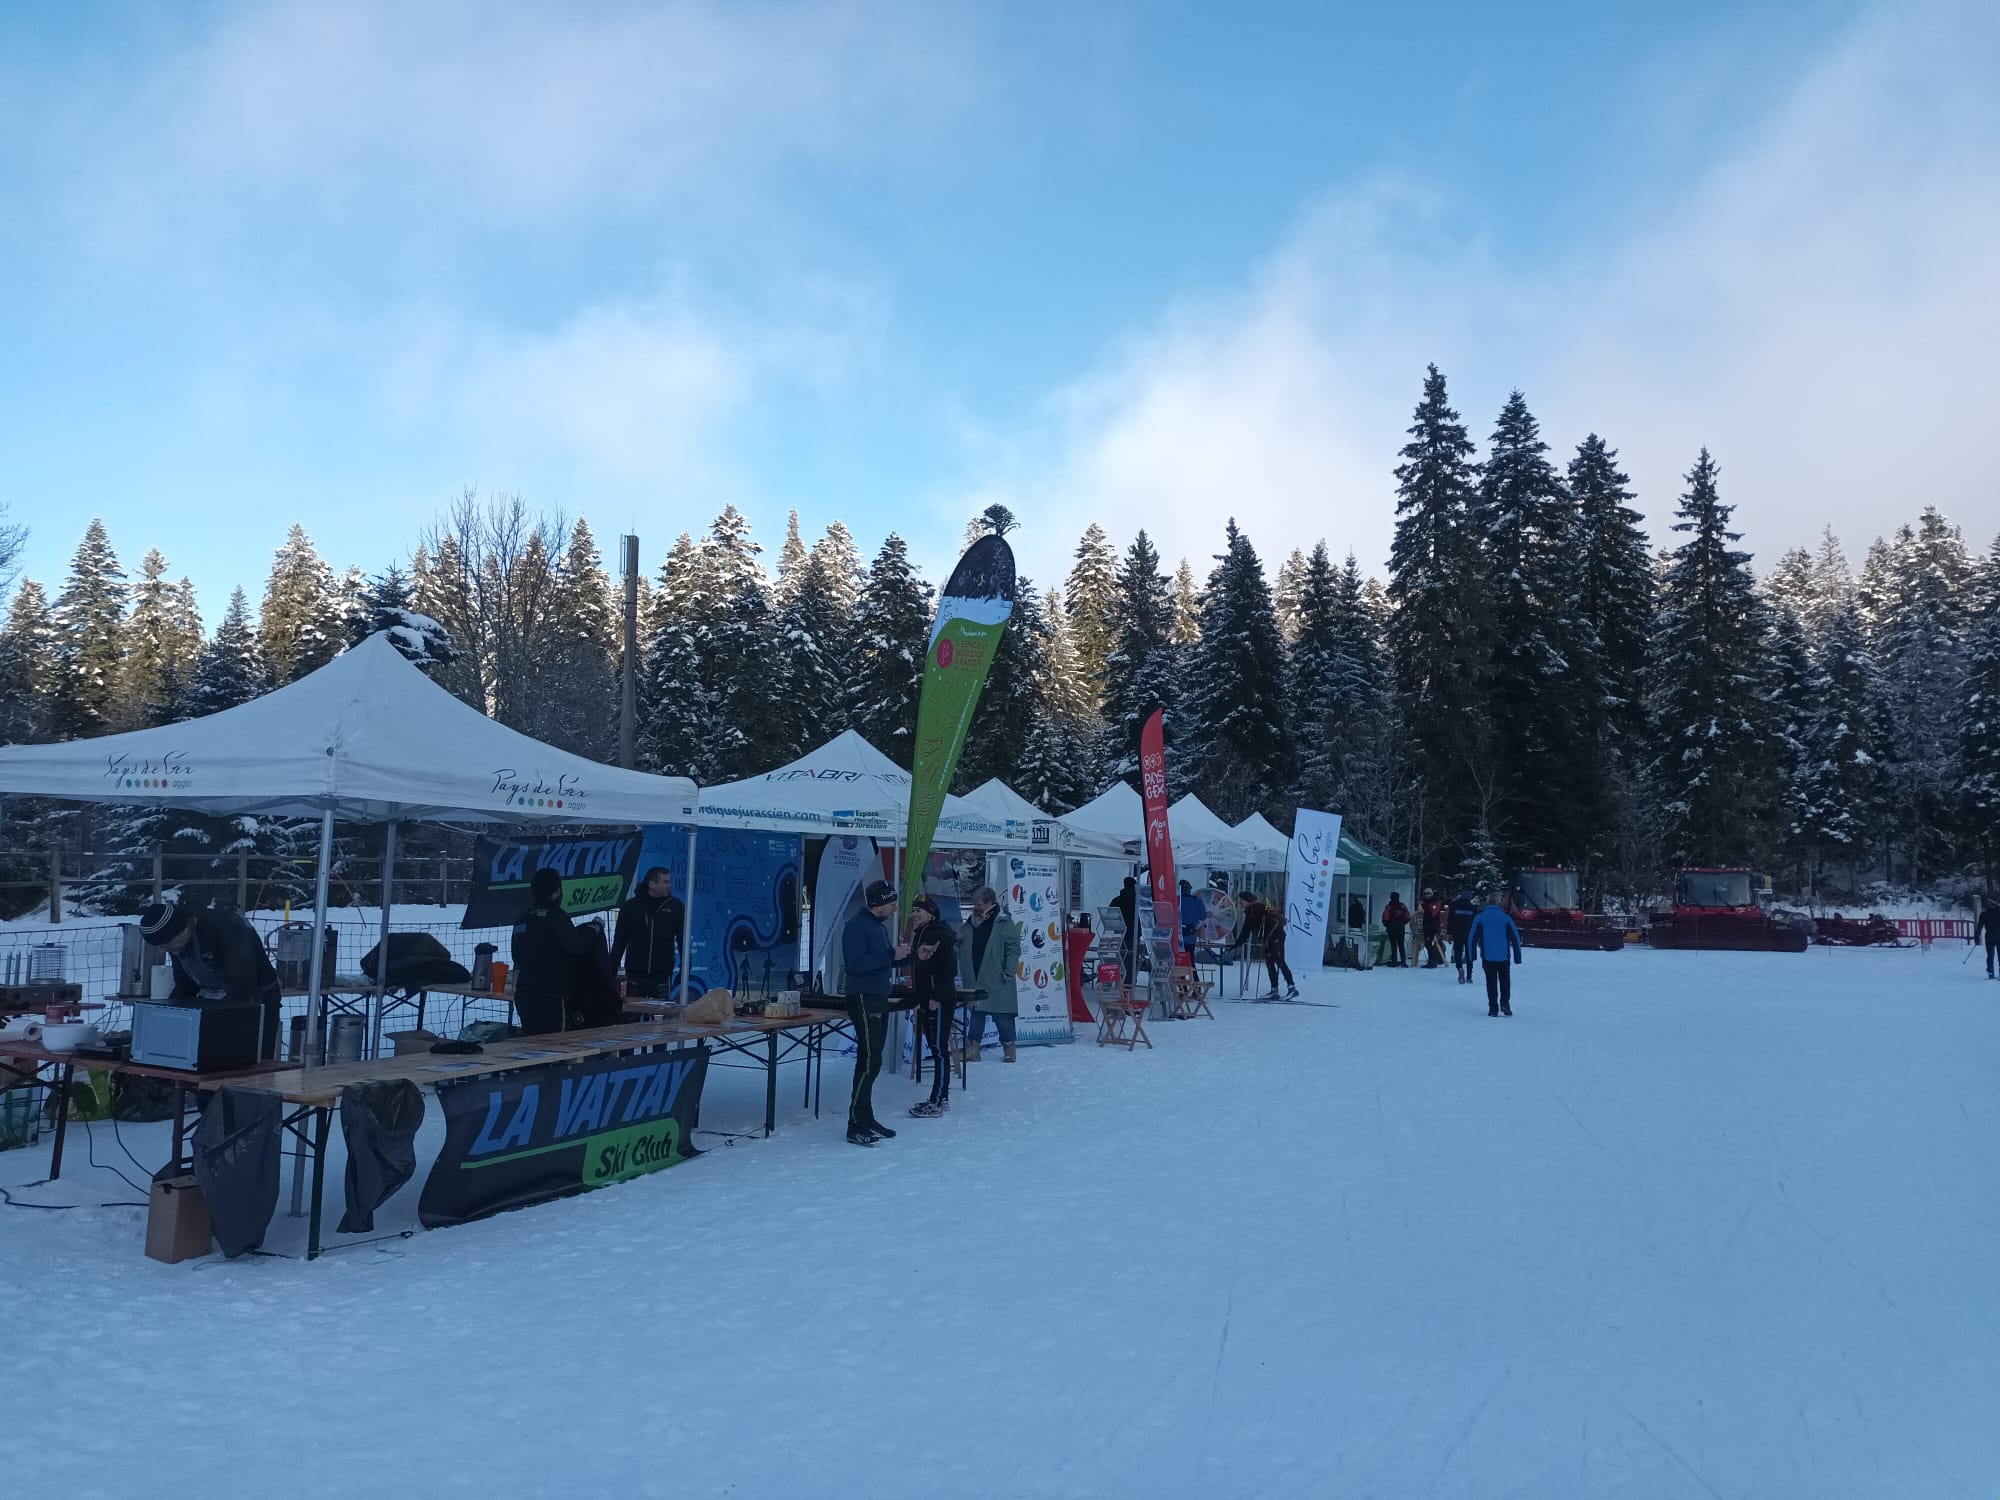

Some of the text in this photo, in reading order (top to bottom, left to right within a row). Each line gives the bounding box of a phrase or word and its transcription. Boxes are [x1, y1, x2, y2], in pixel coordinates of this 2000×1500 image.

[141, 760, 161, 774] de
[490, 768, 530, 806] Pays
[533, 779, 555, 794] de
[698, 804, 821, 822] rdiquejurassien.com
[855, 809, 879, 818] Espace
[936, 817, 1002, 834] rdiquejurassien.com
[491, 838, 636, 883] LA VATTAY
[567, 882, 619, 907] Ski Club
[1287, 828, 1323, 937] Pays de Gex
[469, 1058, 697, 1156] LA VATTAY
[595, 1130, 673, 1179] Ski Club
